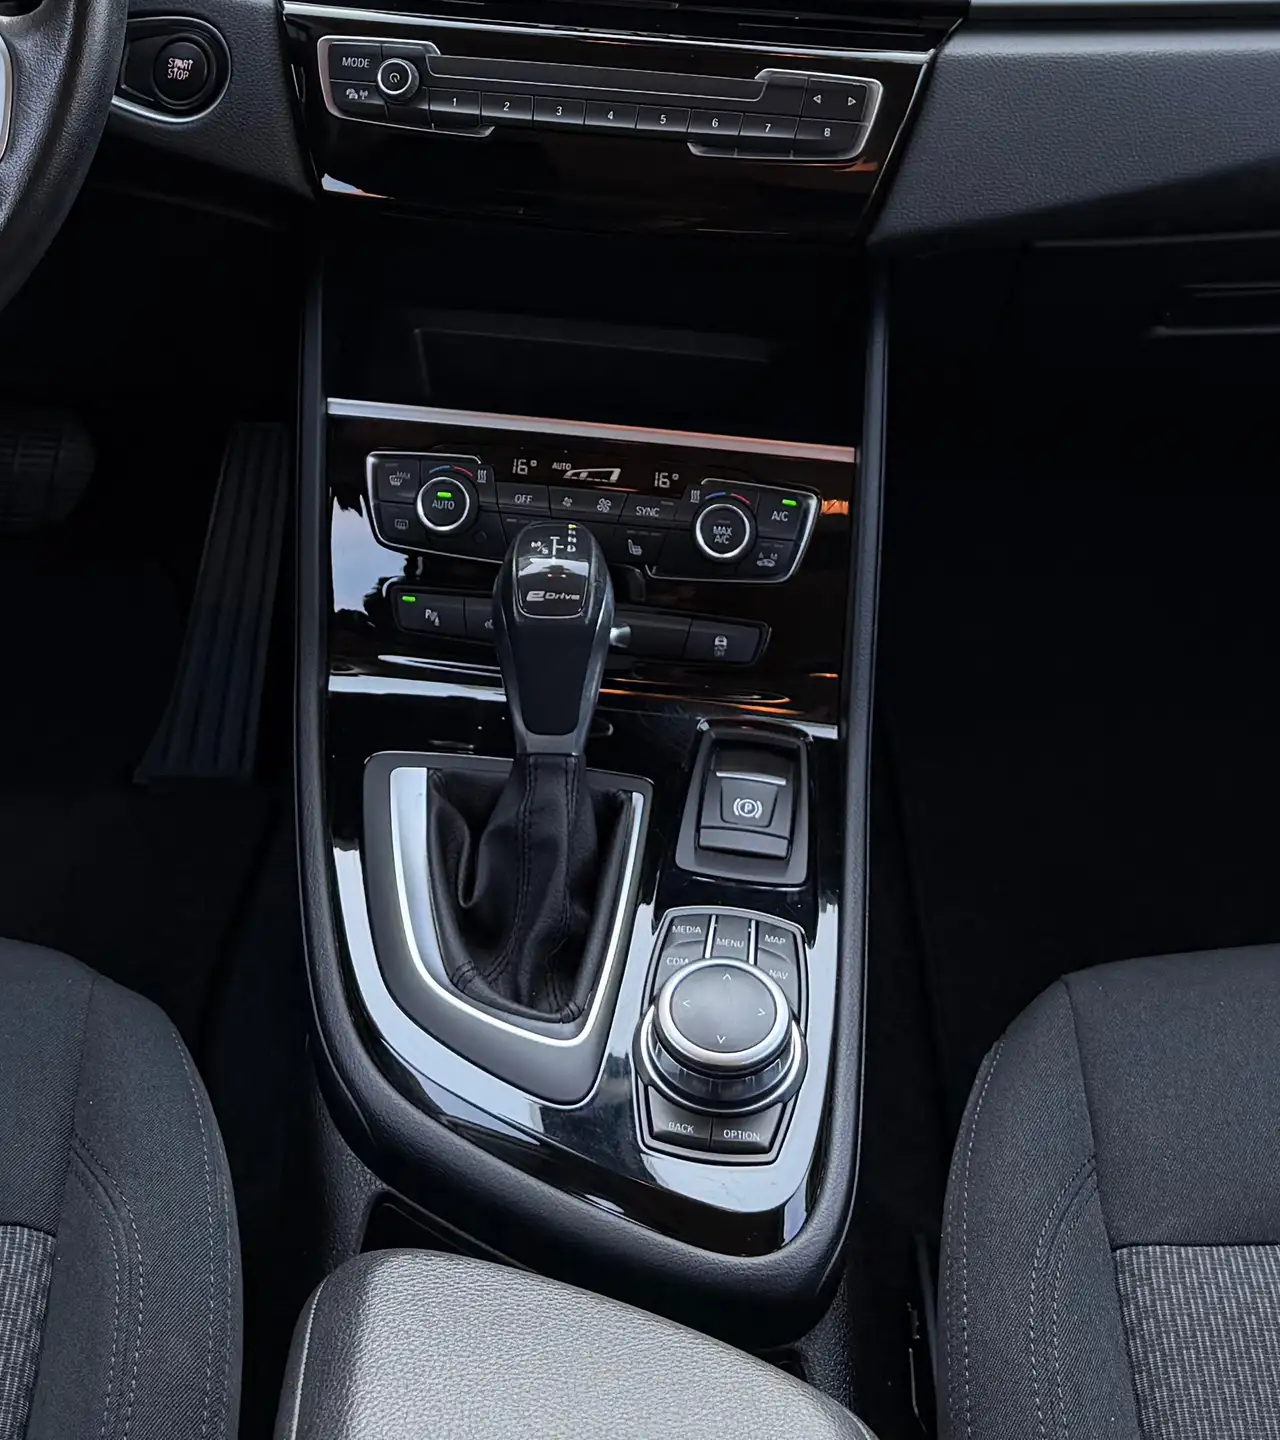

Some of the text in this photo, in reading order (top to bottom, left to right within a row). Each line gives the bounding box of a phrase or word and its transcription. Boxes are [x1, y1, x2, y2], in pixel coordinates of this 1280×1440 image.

[167, 58, 194, 71] START
[341, 56, 371, 68] MODE
[167, 68, 190, 80] STOP
[451, 97, 457, 107] 1
[503, 101, 510, 111] 2
[555, 106, 563, 116] 3
[607, 110, 614, 120] 4
[659, 114, 667, 124] 5
[711, 118, 719, 128] 6
[765, 123, 772, 133] 7
[824, 127, 831, 137] 8
[552, 461, 572, 471] AUTO
[431, 499, 455, 510] AUTO
[514, 494, 533, 504] OFF
[635, 506, 660, 517] SYNC
[771, 510, 789, 522] A/C
[712, 525, 733, 536] MAX
[714, 534, 730, 545] A/C
[672, 925, 702, 935] MEDIA
[716, 937, 745, 948] MENU
[764, 934, 786, 945] MAP
[666, 957, 689, 966] COM
[768, 969, 789, 980] NAV
[668, 1121, 695, 1134] BACK
[723, 1129, 761, 1141] OPTION
